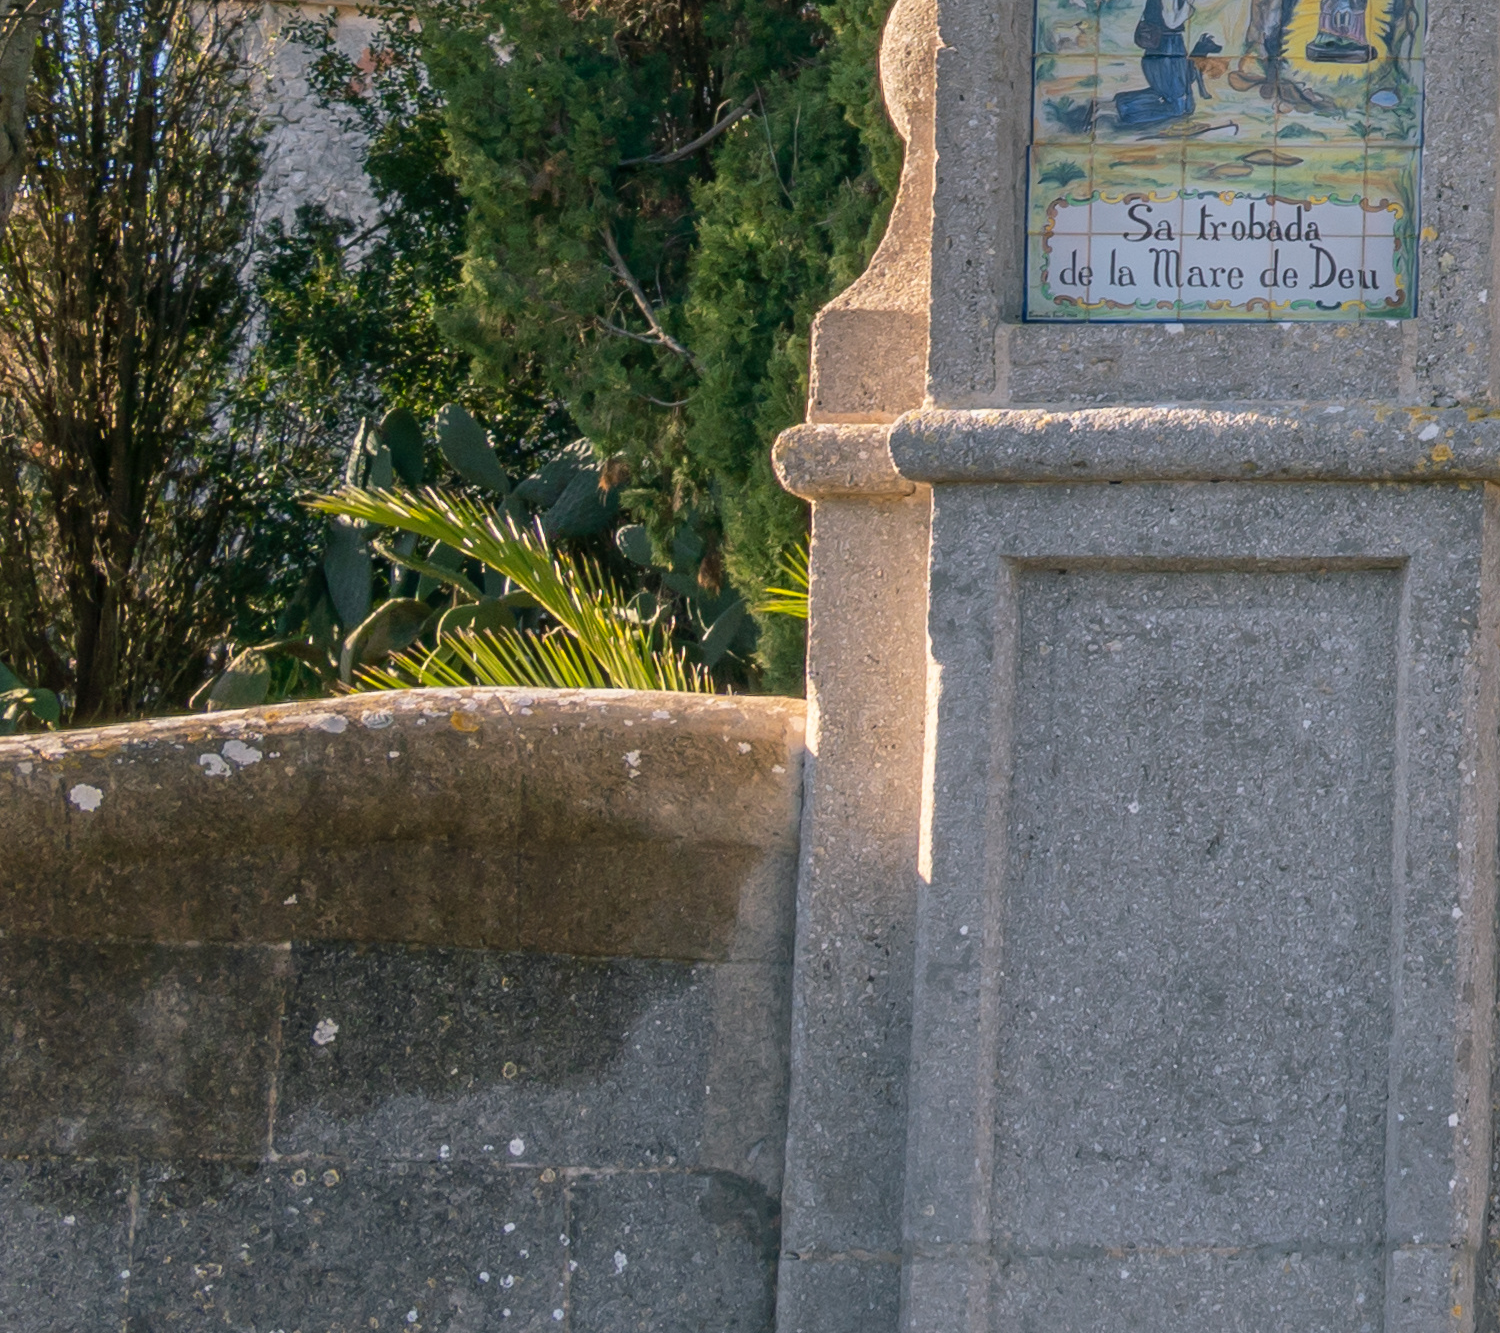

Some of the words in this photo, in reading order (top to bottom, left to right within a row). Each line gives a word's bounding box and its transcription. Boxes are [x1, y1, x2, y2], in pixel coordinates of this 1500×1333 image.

[1123, 203, 1176, 243] Sa
[1196, 201, 1322, 242] trobada
[1059, 248, 1093, 287] de
[1109, 248, 1137, 288] la
[1148, 247, 1245, 290] Mare
[1259, 248, 1298, 289] de
[1309, 243, 1380, 290] Deu
